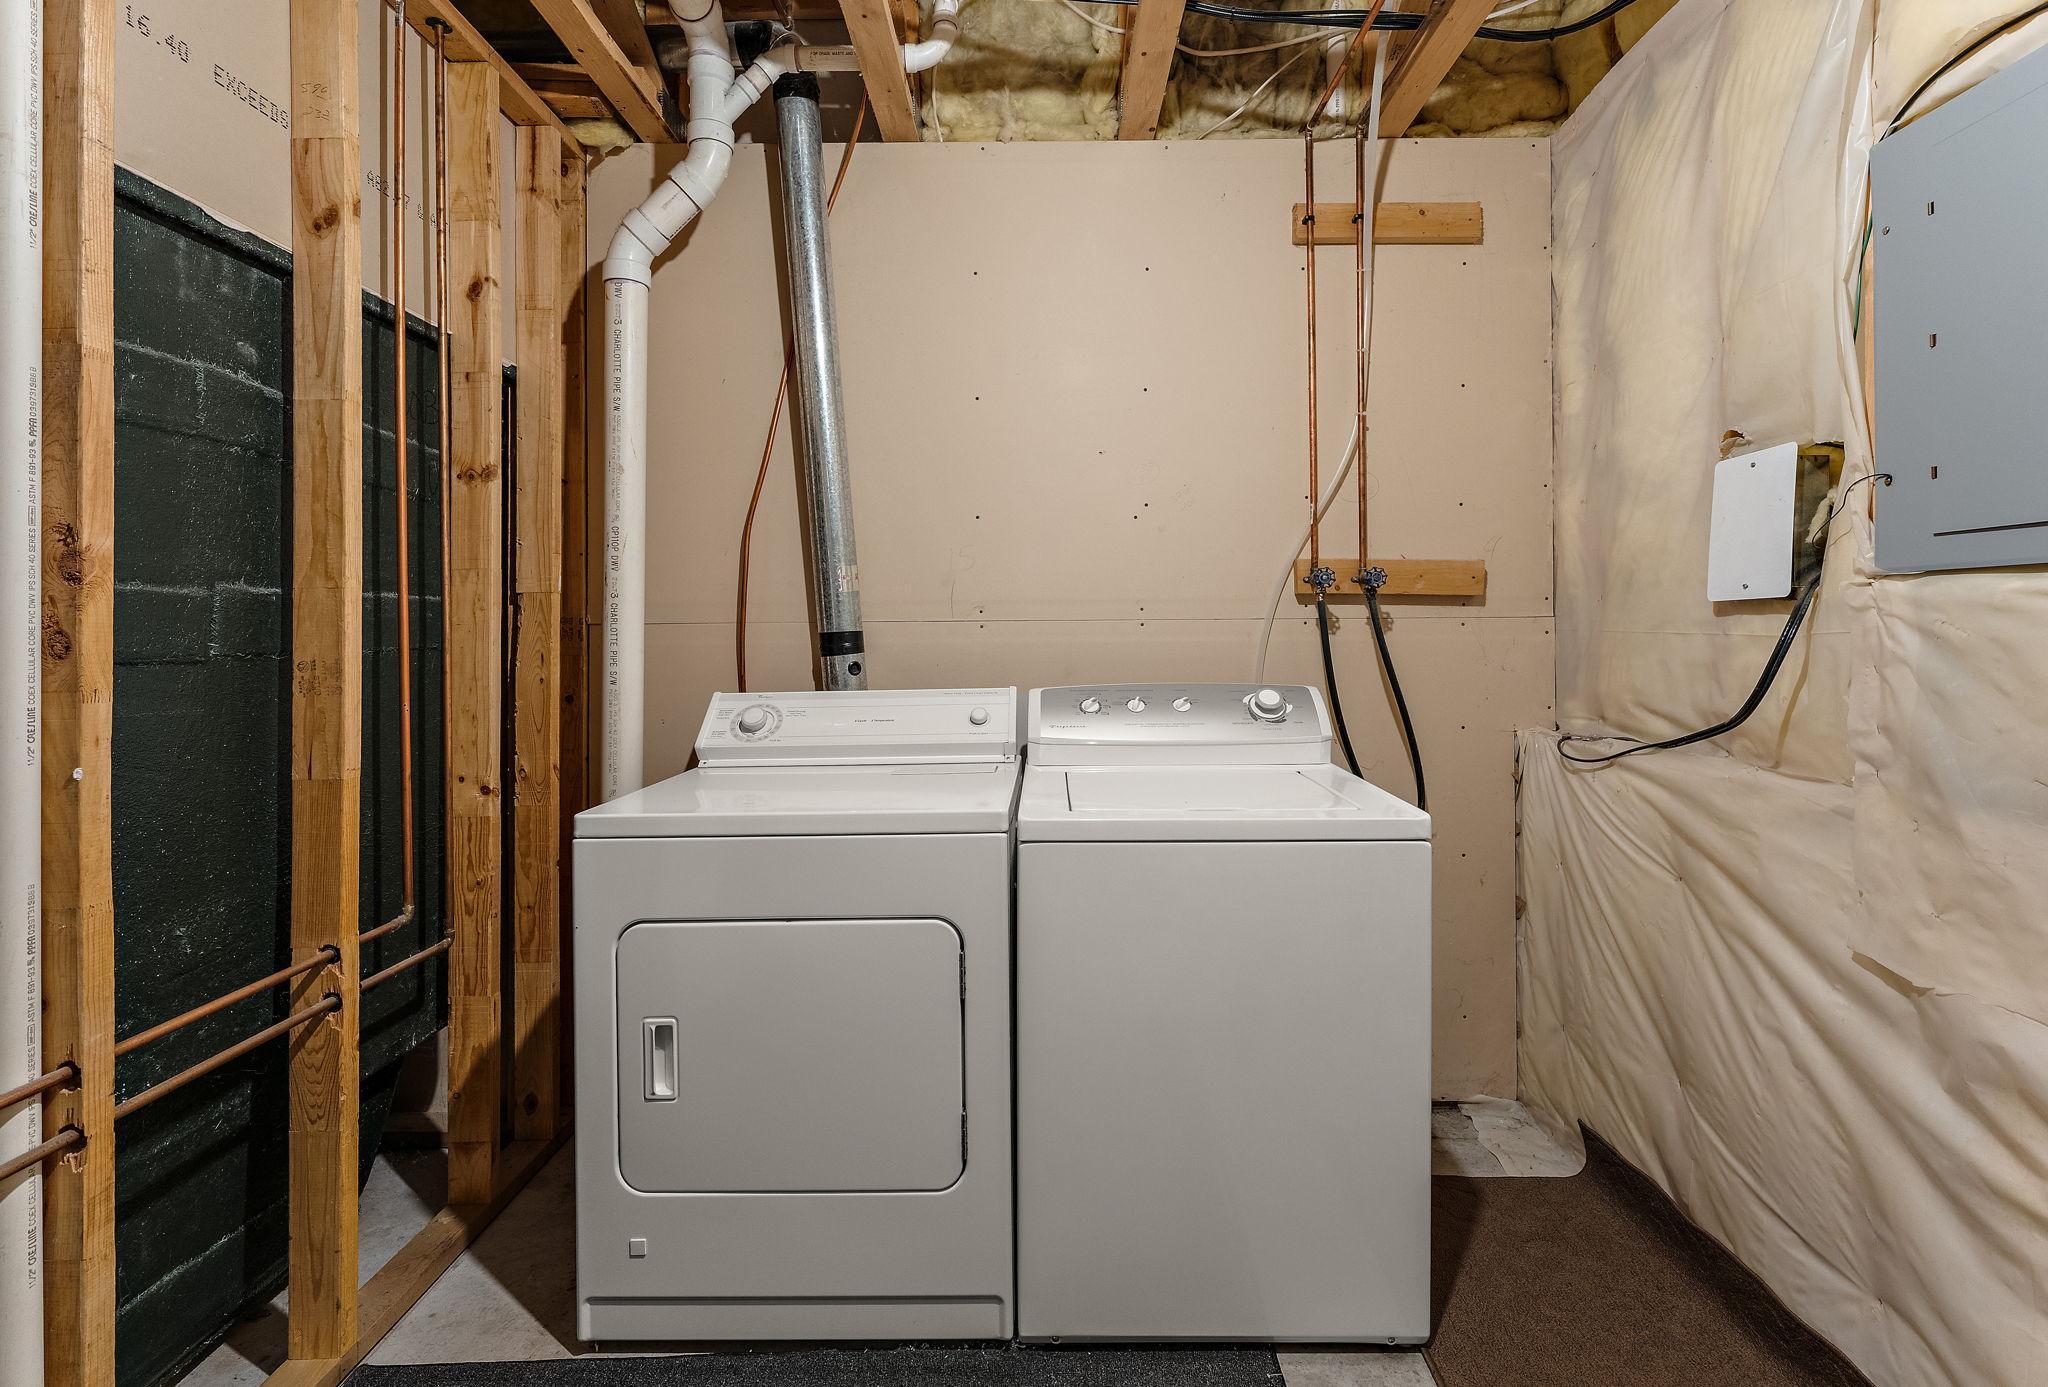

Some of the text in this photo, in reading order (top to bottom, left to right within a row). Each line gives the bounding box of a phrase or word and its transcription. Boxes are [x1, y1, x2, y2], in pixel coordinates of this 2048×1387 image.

[29, 11, 38, 37] SERIES
[29, 37, 38, 48] 40
[29, 48, 38, 63] SCH
[29, 63, 38, 76] IPS
[125, 4, 289, 130] 16.40 EXCEEDS
[29, 76, 38, 94] DWV
[29, 93, 38, 109] PVC
[29, 109, 38, 130] CORE
[29, 131, 38, 168] CELLULAR
[29, 168, 38, 189] COEX
[29, 189, 38, 227] CRESLINE
[614, 282, 623, 299] DWV
[612, 329, 622, 373] CHARLOTTE
[613, 376, 622, 394] PIPE
[613, 396, 621, 411] S/W
[28, 448, 37, 476] 891-93
[28, 483, 37, 505] ASTM
[28, 528, 37, 553] SERIES
[28, 553, 37, 564] 40
[611, 555, 620, 572] DWV
[28, 564, 37, 580] SCH
[28, 580, 37, 592] IPS
[28, 592, 37, 609] DWV
[28, 610, 37, 625] PVC
[609, 602, 619, 648] CHARLOTTE
[28, 626, 37, 646] CORE
[28, 647, 36, 684] CELLULAR
[609, 650, 618, 667] PIPE
[609, 670, 618, 686] S/W
[27, 684, 36, 705] COEX
[27, 706, 36, 744] CRESLINE
[27, 966, 36, 994] 891-93
[27, 1001, 36, 1023] ASTM
[27, 1045, 36, 1072] SERIES
[28, 1166, 37, 1205] CELLULAR
[28, 1205, 37, 1226] COEX
[27, 1226, 37, 1266] CRESLINE
